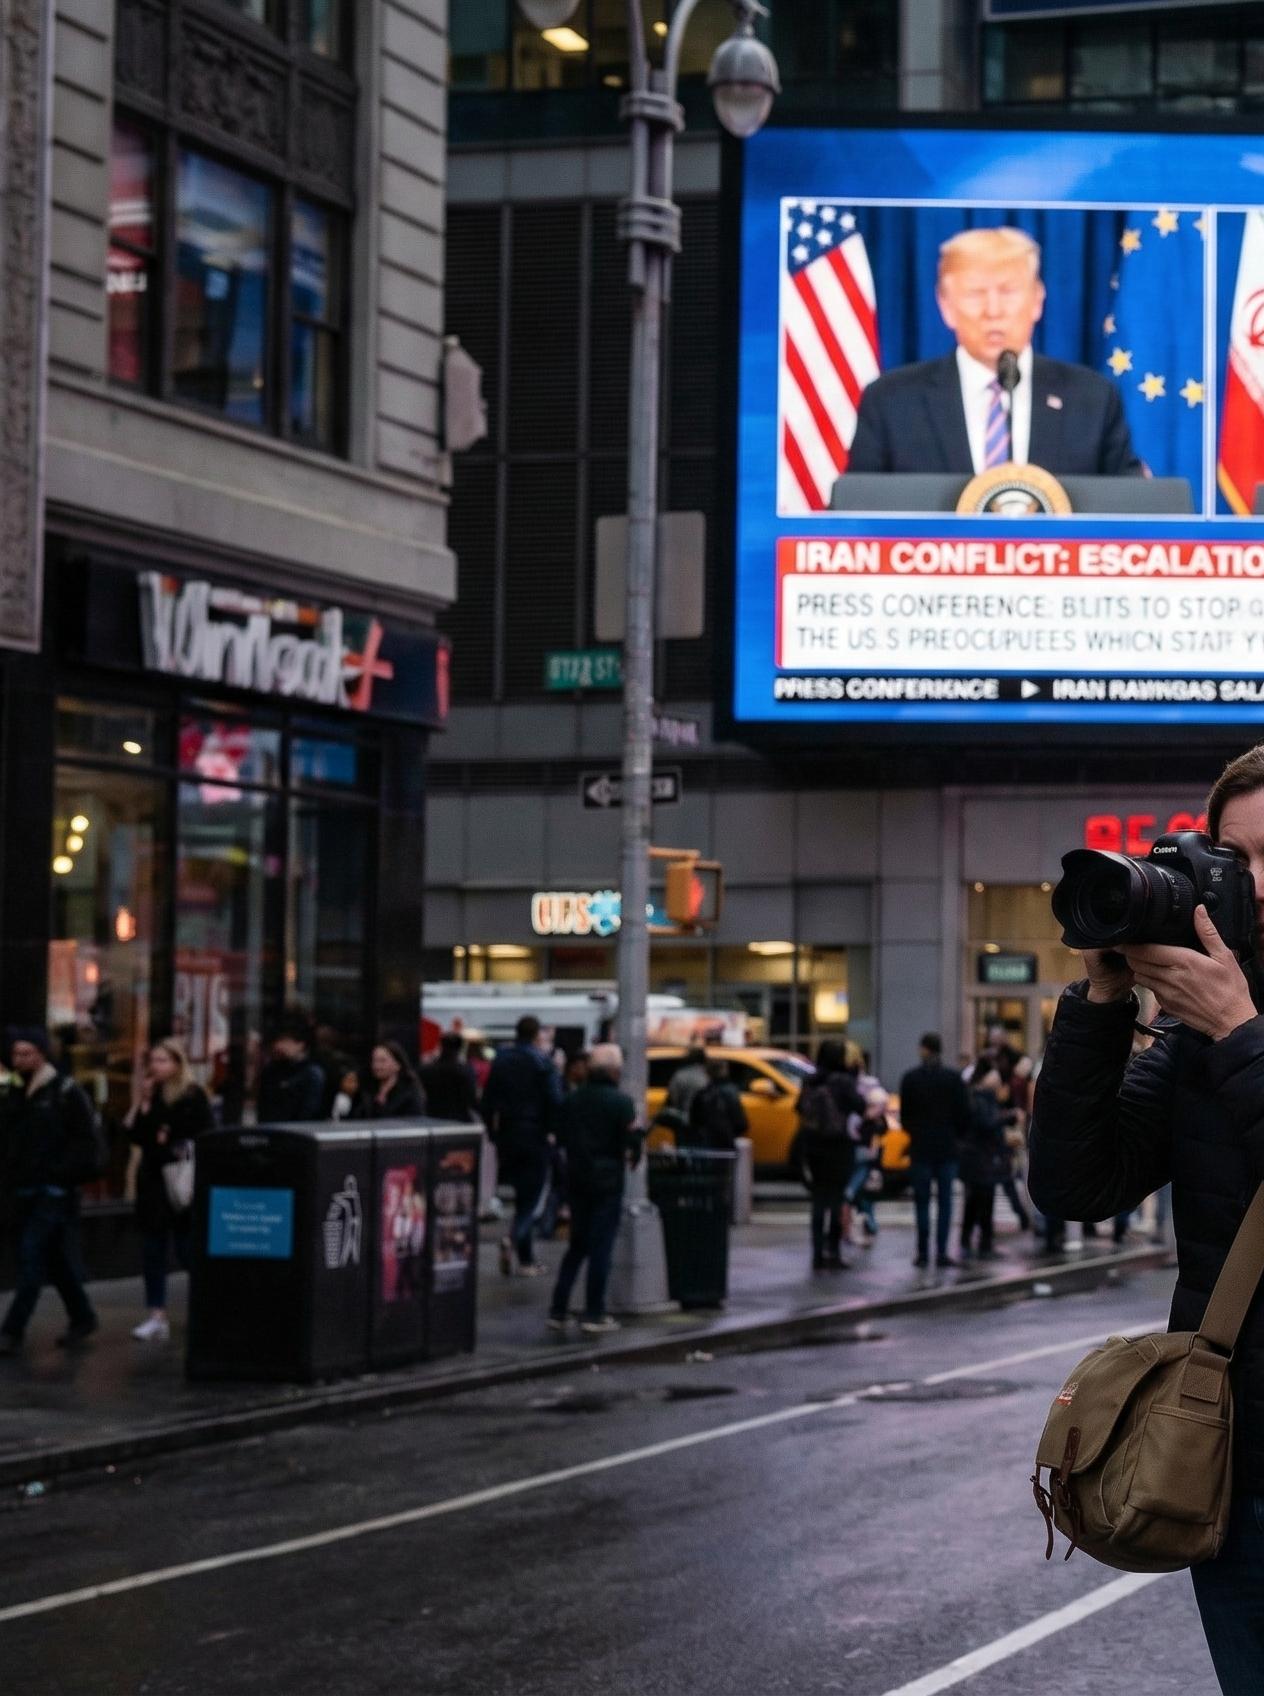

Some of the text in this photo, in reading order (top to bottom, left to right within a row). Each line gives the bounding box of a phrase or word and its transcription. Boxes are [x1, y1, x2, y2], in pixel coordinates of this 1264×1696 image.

[796, 541, 880, 573] IRAN
[890, 542, 1070, 575] CONFLICT:
[797, 593, 874, 617] PRESS
[1140, 597, 1170, 619] TO
[1180, 598, 1240, 620] STOP
[797, 627, 839, 649] THE
